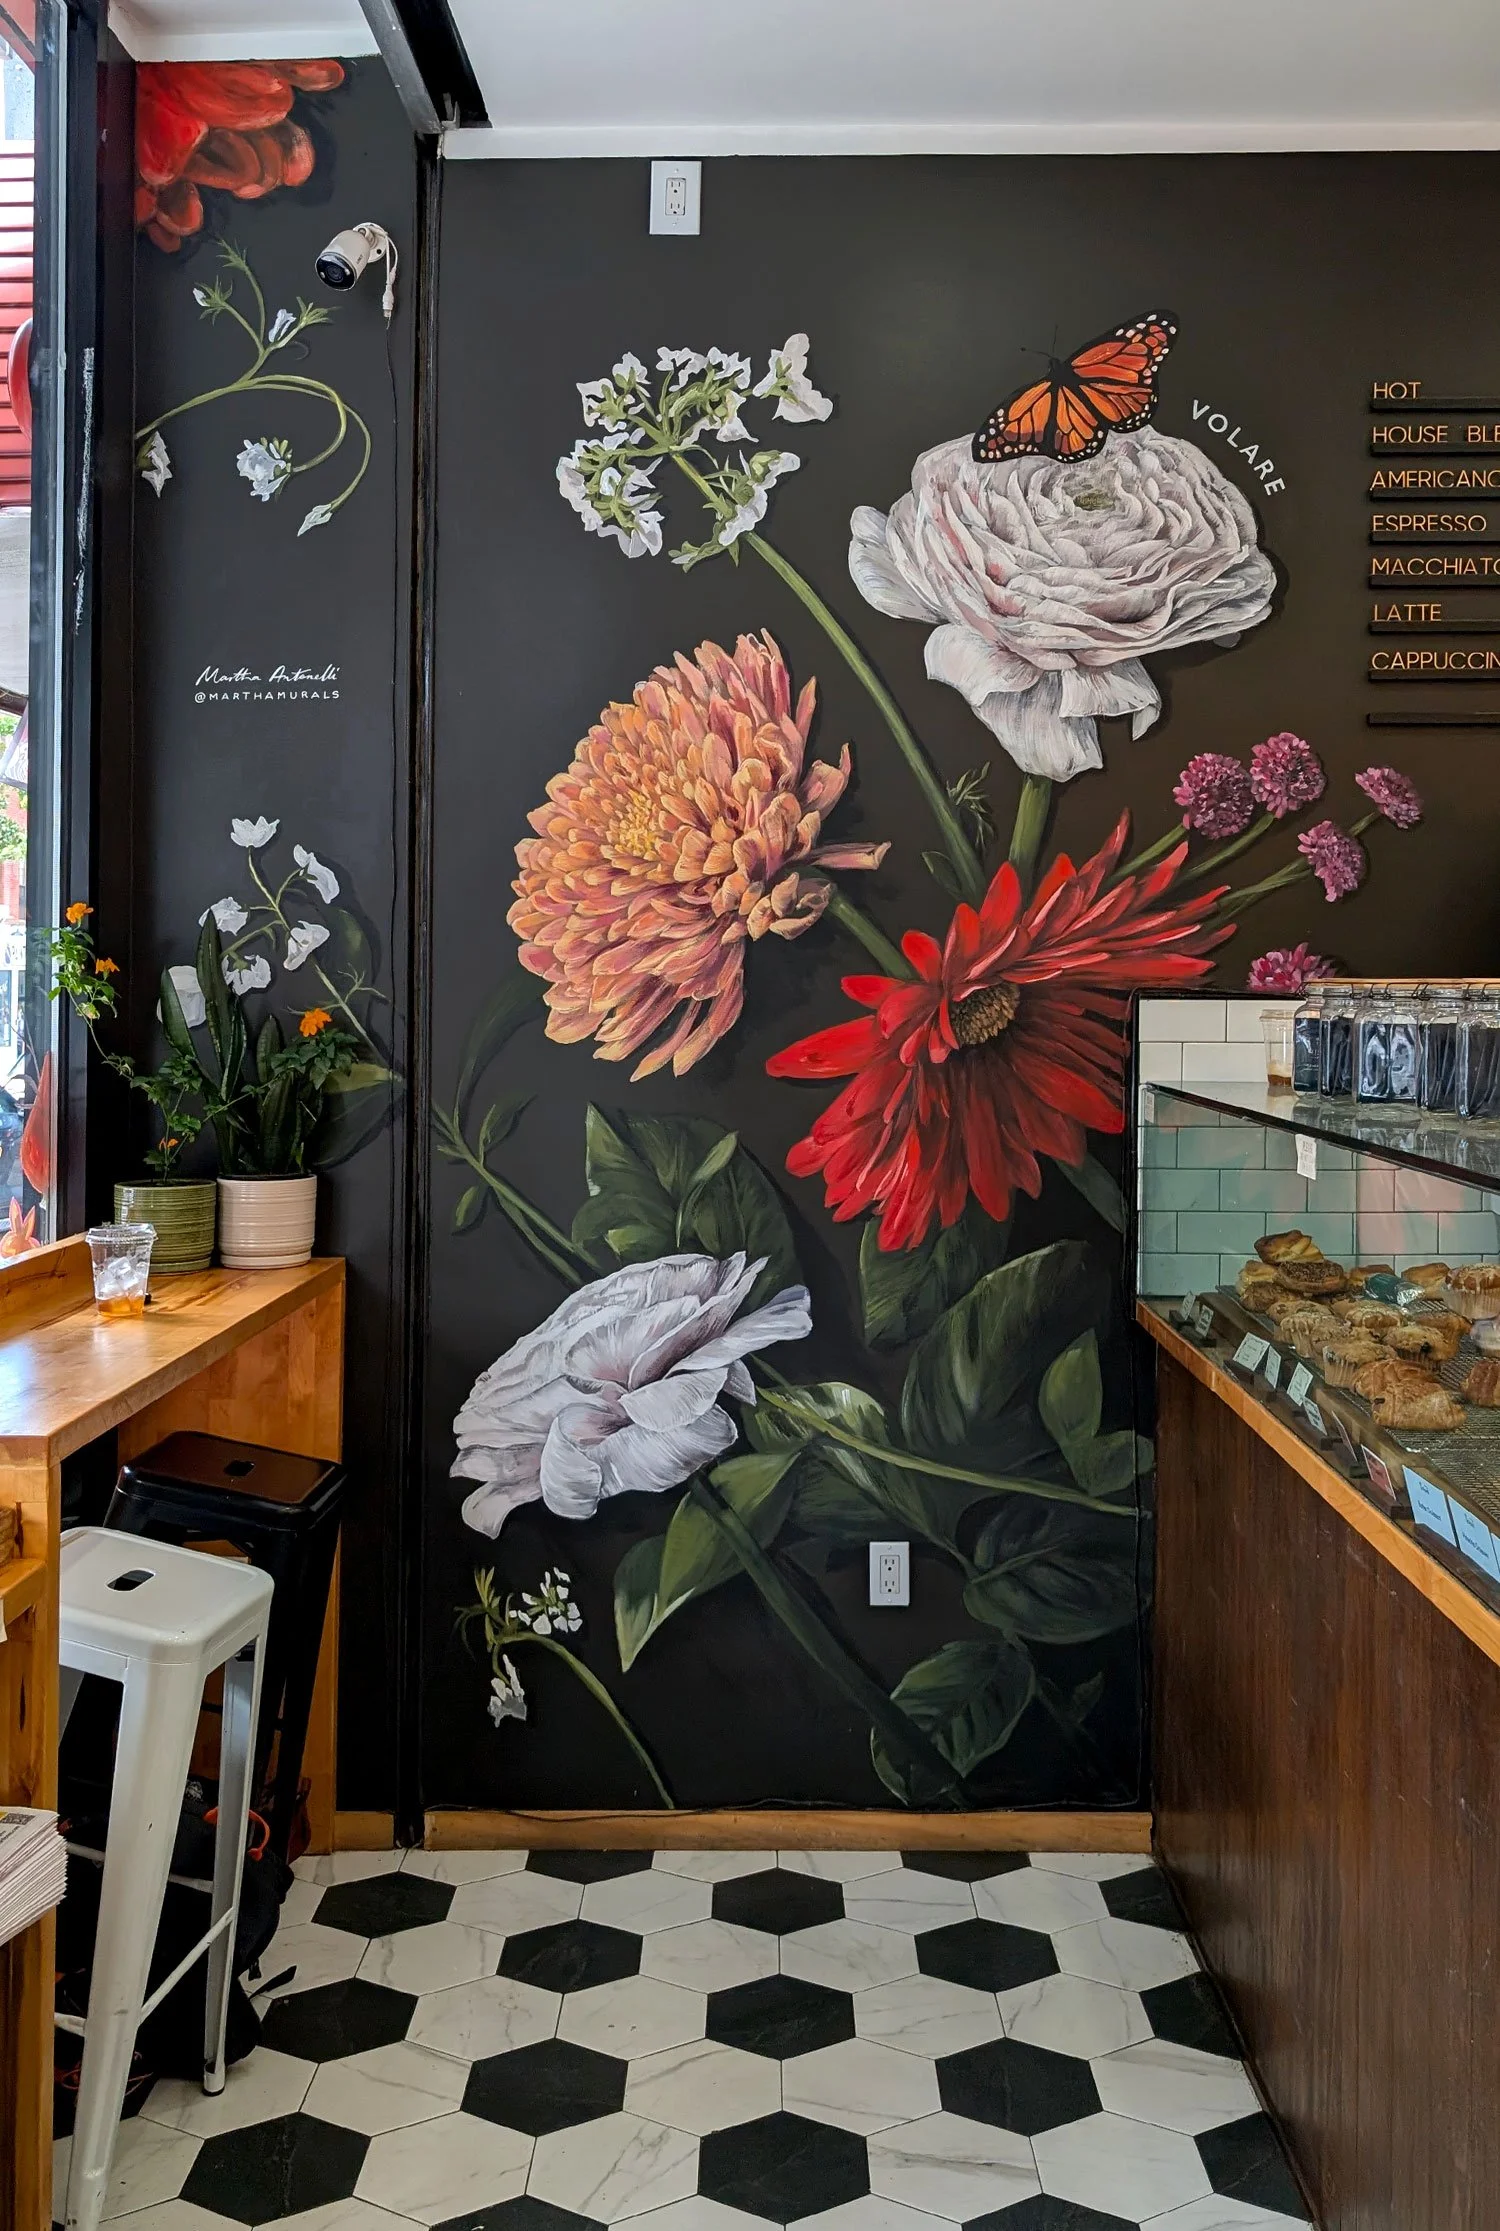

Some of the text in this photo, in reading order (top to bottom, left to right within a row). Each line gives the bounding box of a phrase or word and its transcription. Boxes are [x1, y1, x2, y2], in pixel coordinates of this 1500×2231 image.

[1373, 381, 1422, 400] HOT
[1372, 425, 1449, 444] HOUSE
[1191, 398, 1287, 497] VOLARE
[1372, 514, 1487, 532] ESPRESSO
[1374, 603, 1442, 622] LATTE
[195, 663, 341, 686] Martha Antonelli
[194, 690, 341, 704] @MARTHAMURALS
